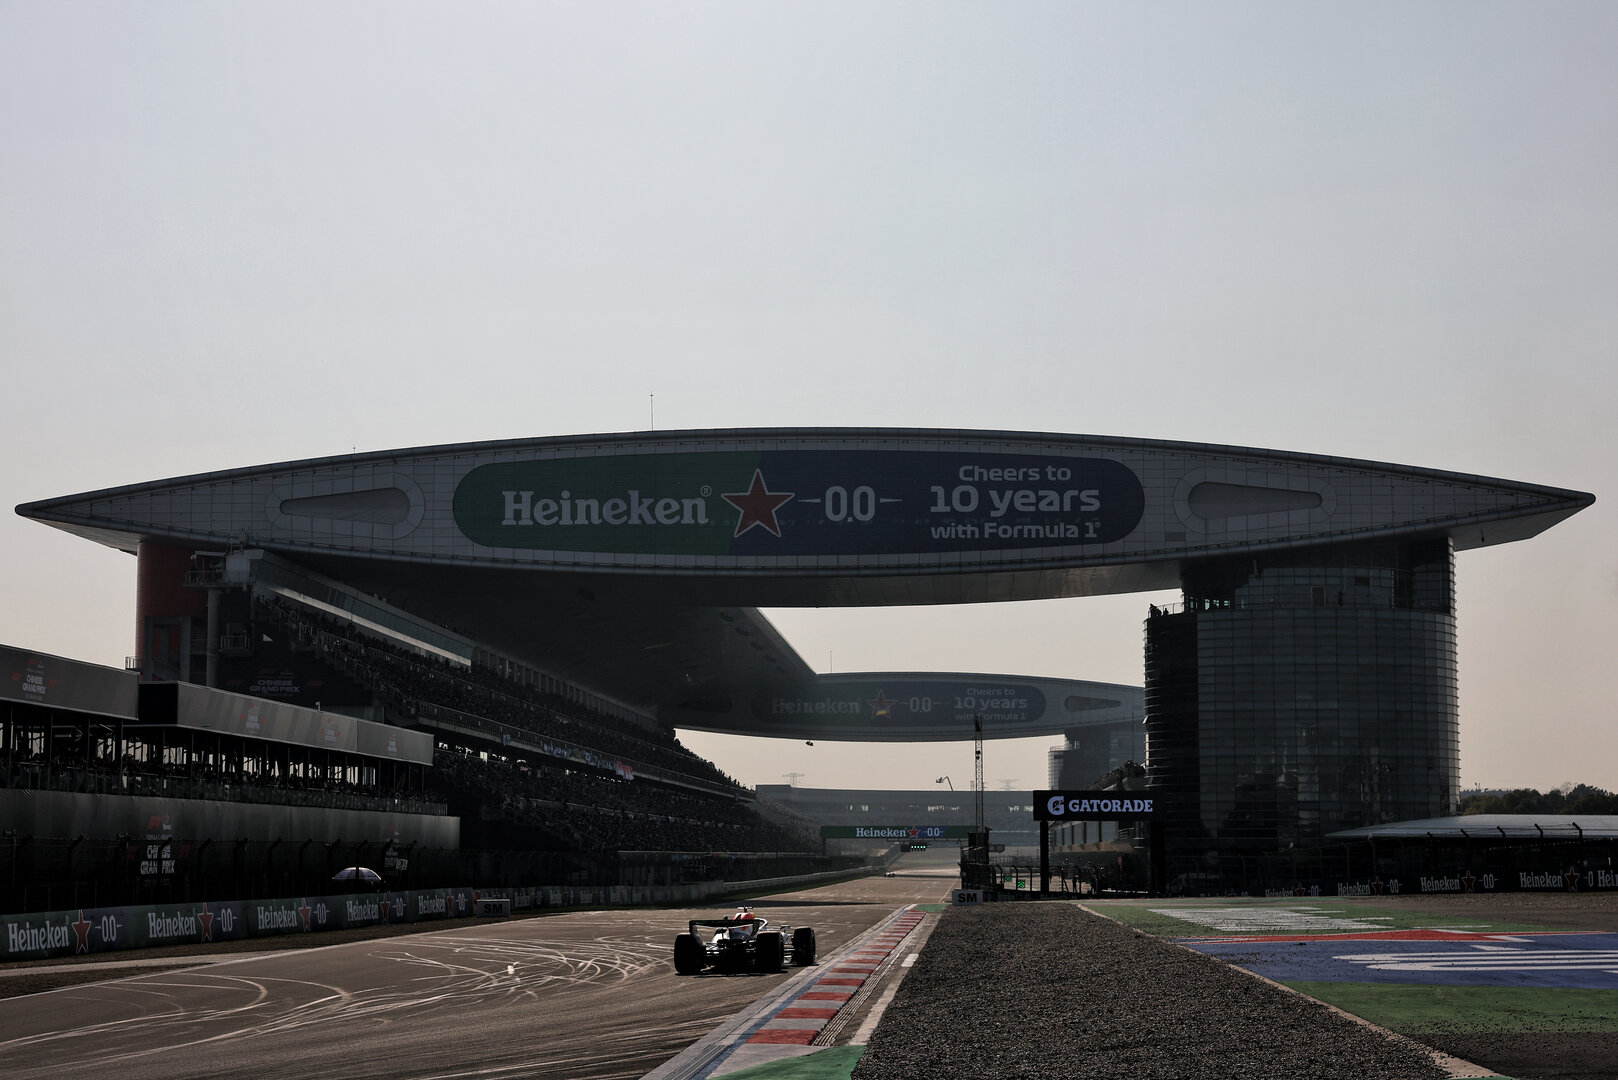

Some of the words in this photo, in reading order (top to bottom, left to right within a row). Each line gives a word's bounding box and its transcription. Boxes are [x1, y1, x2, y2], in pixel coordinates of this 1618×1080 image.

[959, 465, 1040, 482] Cheers
[1045, 465, 1072, 481] to
[930, 485, 979, 513] 10
[989, 489, 1100, 518] years
[931, 521, 979, 539] with
[984, 521, 1079, 539] Formula
[966, 687, 1002, 696] Cheers
[1004, 687, 1016, 696] to
[772, 697, 860, 714] Heineken
[954, 697, 975, 709] 10
[979, 698, 1028, 711] years
[1068, 799, 1153, 813] GATORADE
[855, 827, 907, 838] Heineken
[140, 860, 159, 875] GRAN
[1420, 875, 1460, 892] Heineken
[1519, 871, 1563, 888] Heineken
[957, 892, 977, 903] SM
[1337, 881, 1371, 897] Heineken
[346, 899, 379, 922] Heineken
[484, 903, 503, 914] SM
[147, 910, 197, 939] Heineken
[257, 905, 298, 930] Heineken
[7, 919, 70, 953] Heineken
